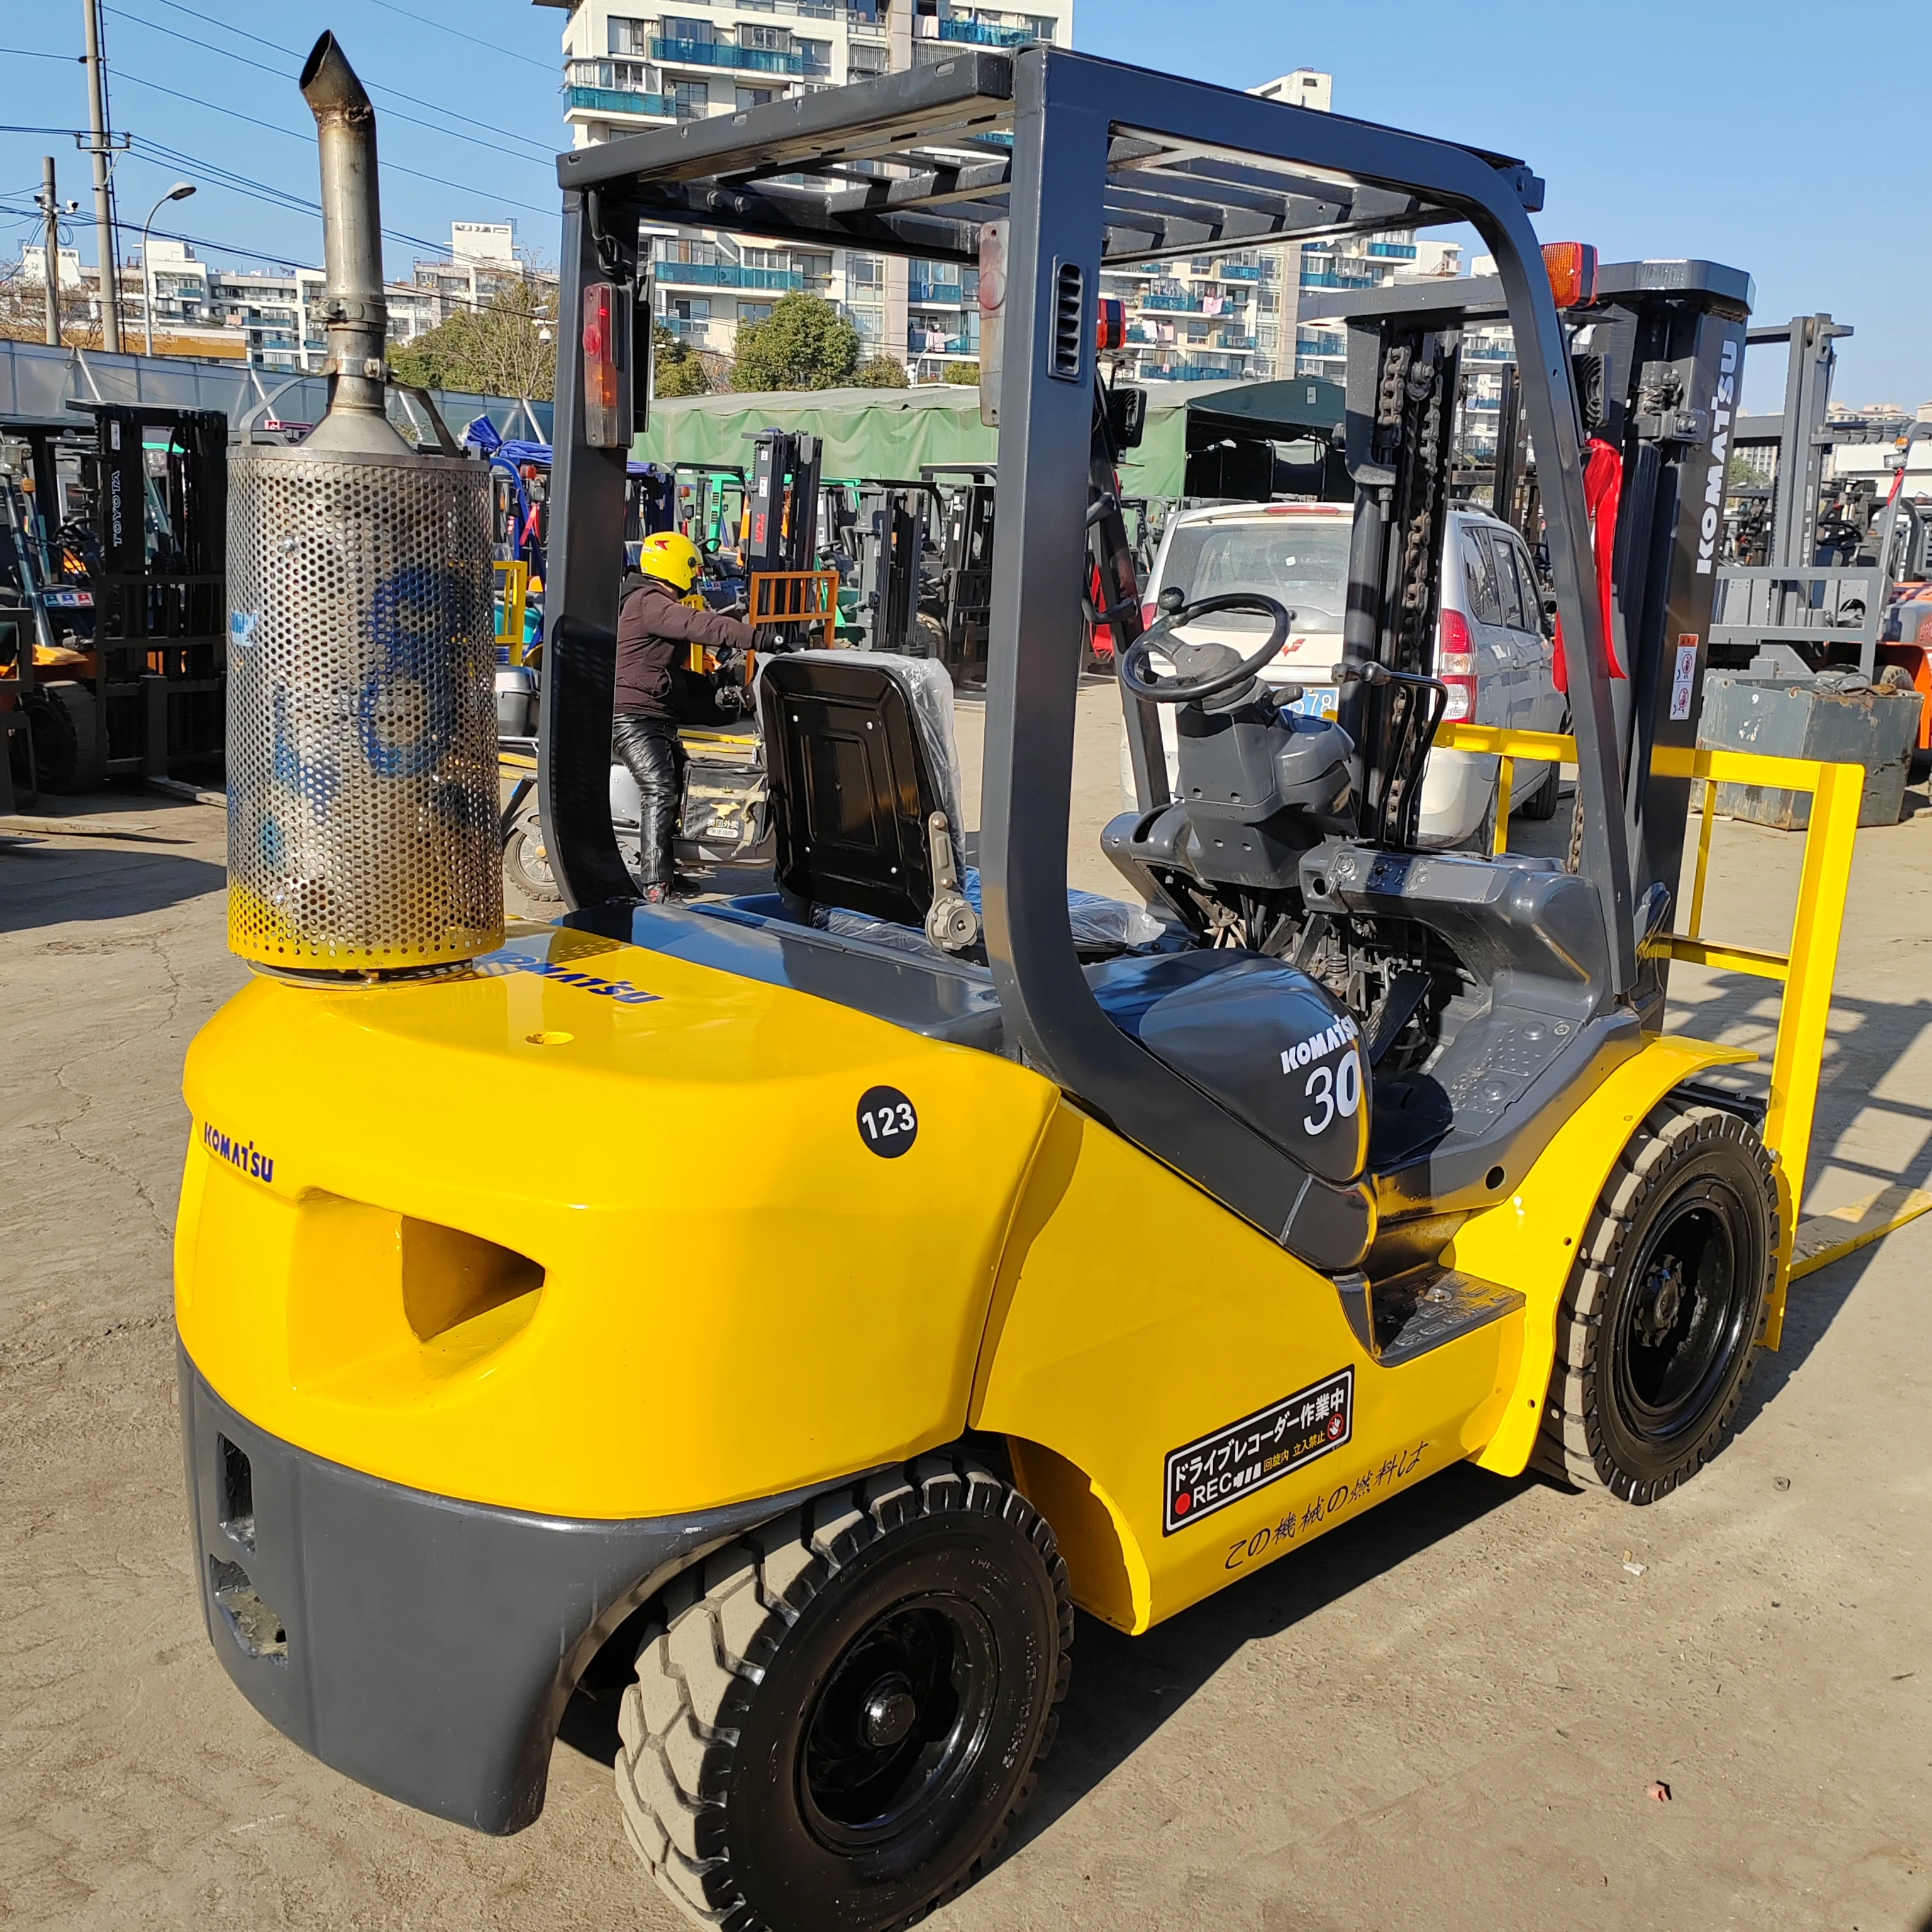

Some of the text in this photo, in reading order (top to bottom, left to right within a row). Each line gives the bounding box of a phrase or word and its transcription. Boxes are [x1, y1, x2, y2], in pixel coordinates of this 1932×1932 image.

[1696, 340, 1738, 574] KOMATSU
[111, 470, 123, 547] TOYOTA
[1802, 517, 1812, 567] HELI
[707, 819, 740, 830] 美团外卖
[1280, 1014, 1359, 1074] KOMATSU
[862, 1103, 914, 1140] 123
[1304, 1050, 1362, 1135] 30
[204, 1121, 274, 1183] KOMATSU
[1175, 1387, 1345, 1492] ドライブレコーダー作業中
[1292, 1430, 1326, 1457] 立入禁止
[1193, 1472, 1232, 1508] REC
[1224, 1440, 1429, 1570] この機械の燃料は
